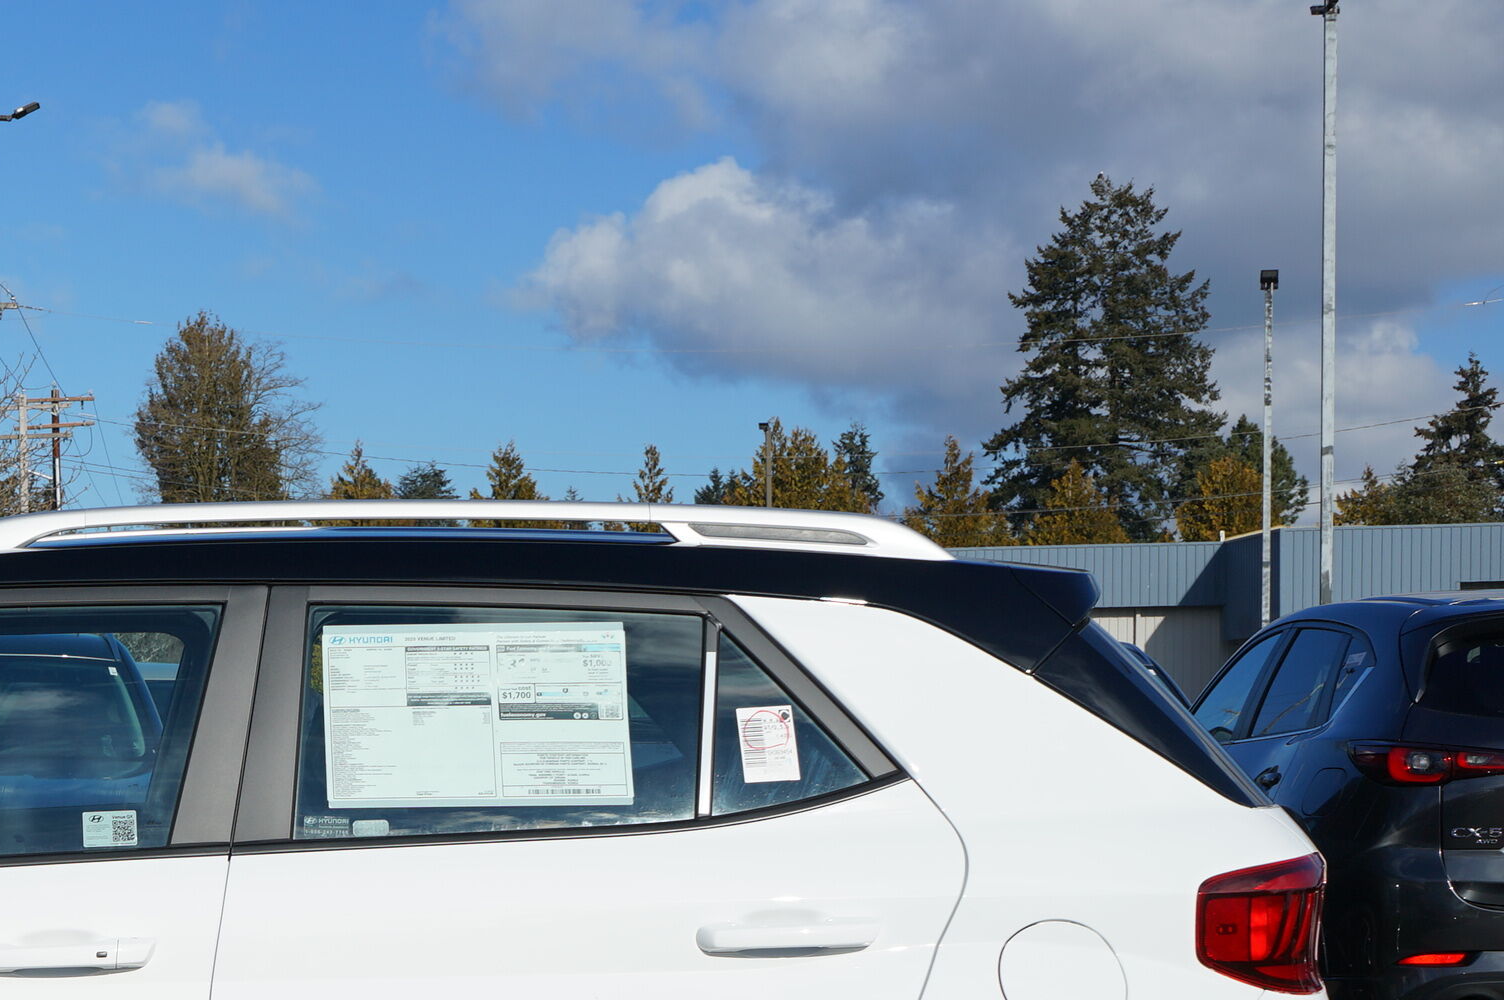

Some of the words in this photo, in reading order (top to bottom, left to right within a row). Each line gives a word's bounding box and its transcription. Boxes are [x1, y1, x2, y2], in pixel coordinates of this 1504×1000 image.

[348, 636, 393, 644] HYUNDAI
[502, 691, 531, 700] $1,700
[1451, 827, 1503, 838] CX-5
